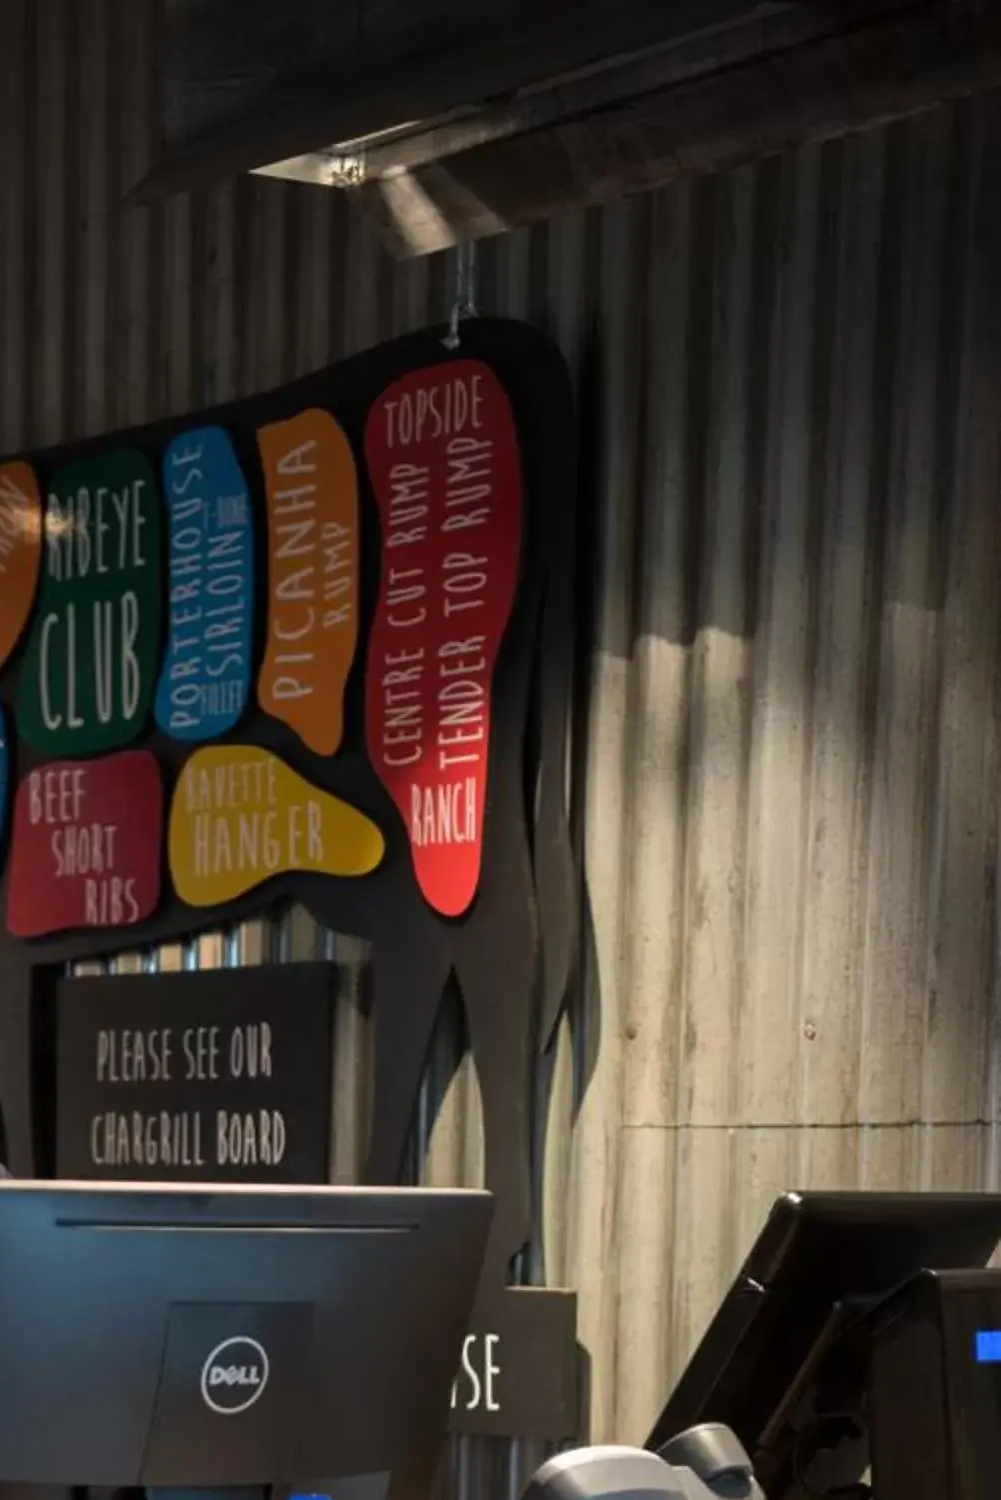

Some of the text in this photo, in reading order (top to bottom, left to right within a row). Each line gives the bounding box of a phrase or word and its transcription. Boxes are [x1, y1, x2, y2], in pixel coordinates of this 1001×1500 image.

[384, 375, 484, 449] TOPSIDE
[46, 480, 146, 581] RIBEYE
[170, 443, 204, 729] PORTERHOUSE
[204, 529, 245, 677] SIRLOIN
[272, 439, 317, 700] PICANHA
[323, 522, 350, 628] RUMP
[438, 437, 493, 770] TENDER TOP RUMP
[383, 463, 429, 767] CENTRE CUT RUMP
[40, 590, 140, 730] CLUB
[29, 769, 86, 825] BEEF
[411, 776, 476, 848] RANCH
[52, 825, 119, 877] SHORT
[195, 801, 323, 876] HANGER
[85, 878, 139, 926] RIBS
[97, 1022, 273, 1083] PLEASE SEE OUR
[92, 1109, 286, 1167] CHARGRILL BOARD
[209, 1364, 261, 1387] DELL
